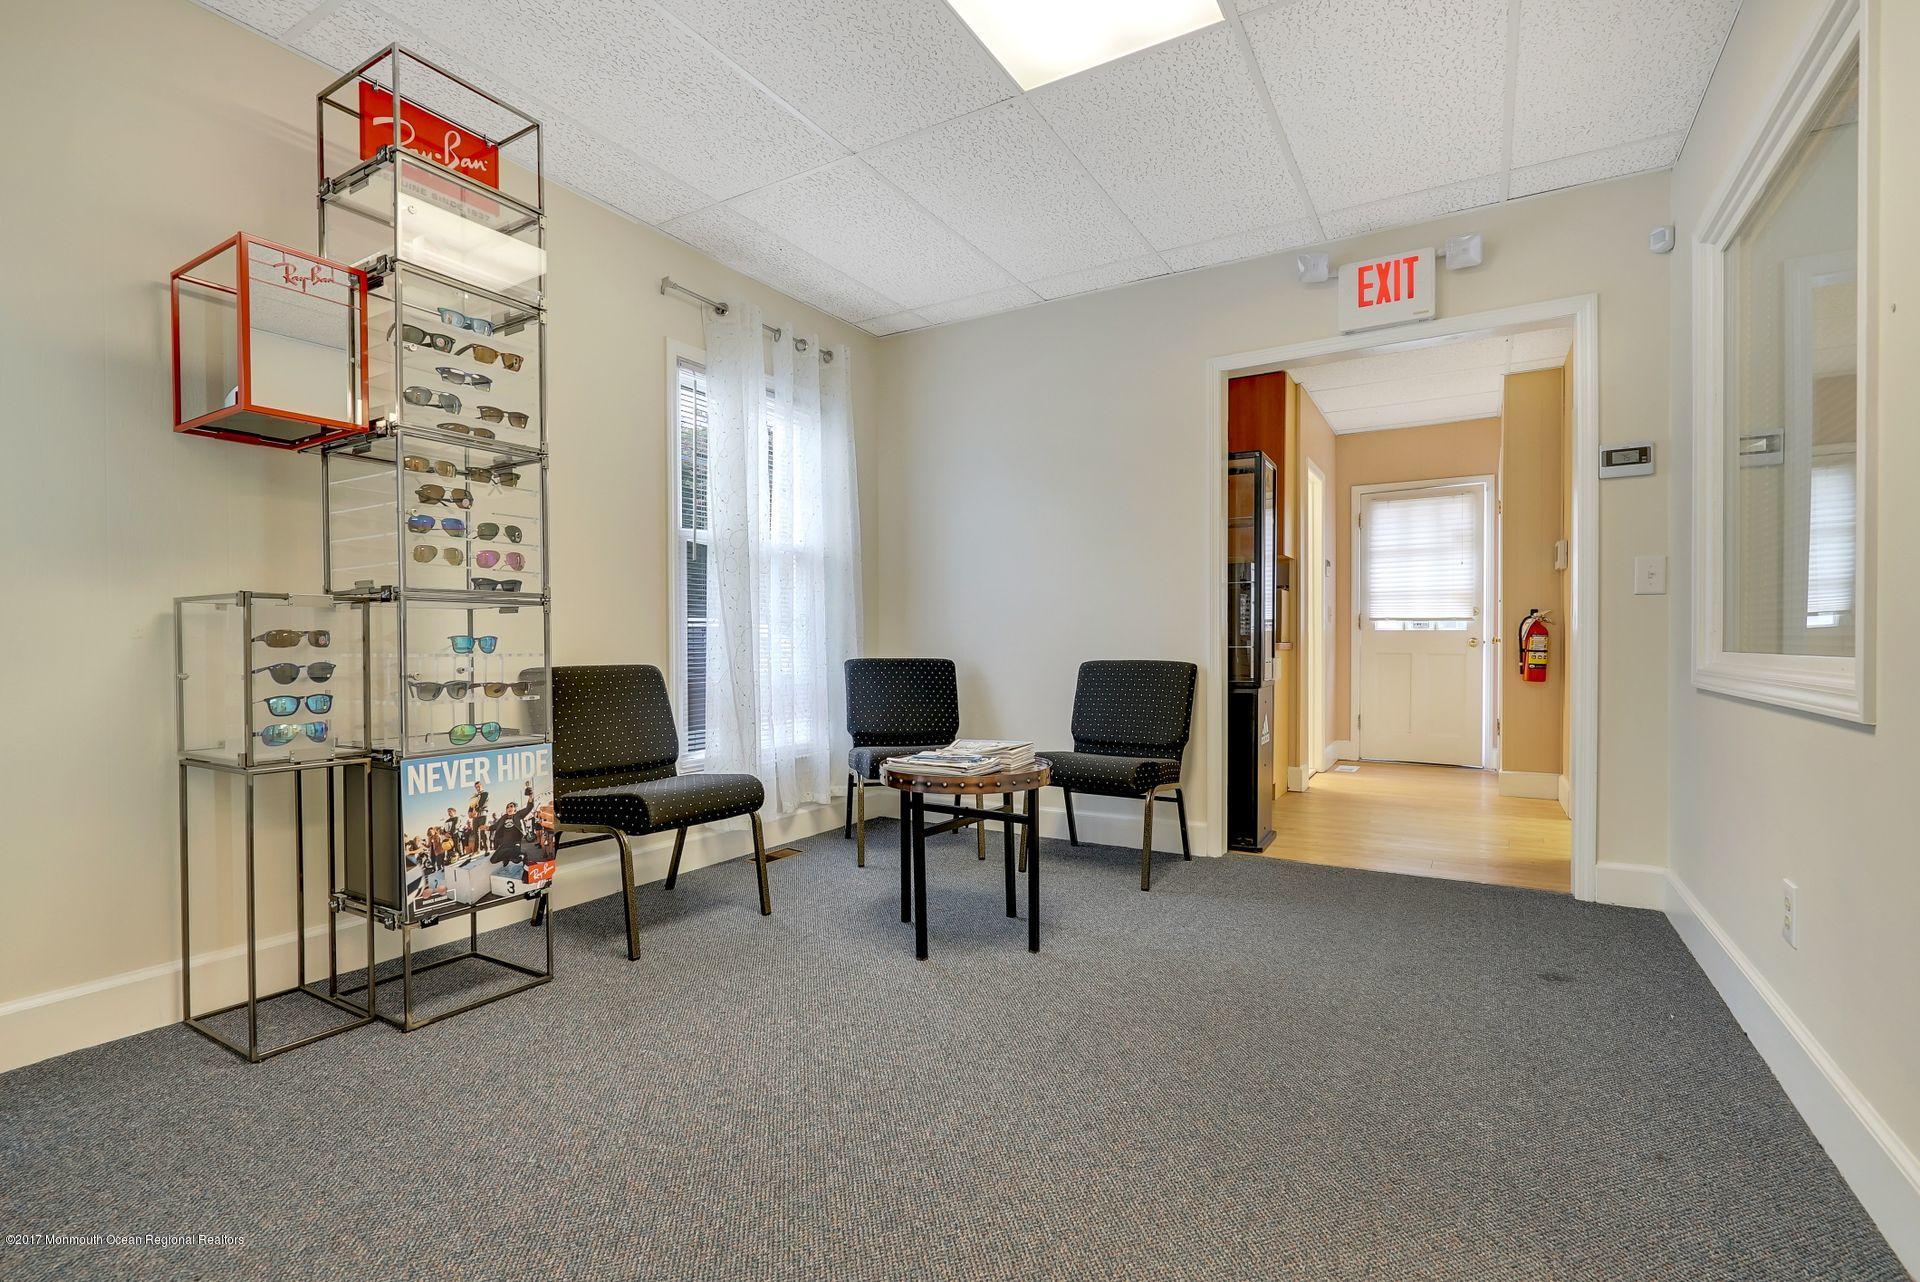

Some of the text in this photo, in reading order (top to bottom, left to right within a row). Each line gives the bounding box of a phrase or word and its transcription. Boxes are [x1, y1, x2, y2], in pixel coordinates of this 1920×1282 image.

[1358, 256, 1419, 308] EXIT
[407, 749, 549, 796] NEVER HIDE
[507, 881, 515, 894] 3
